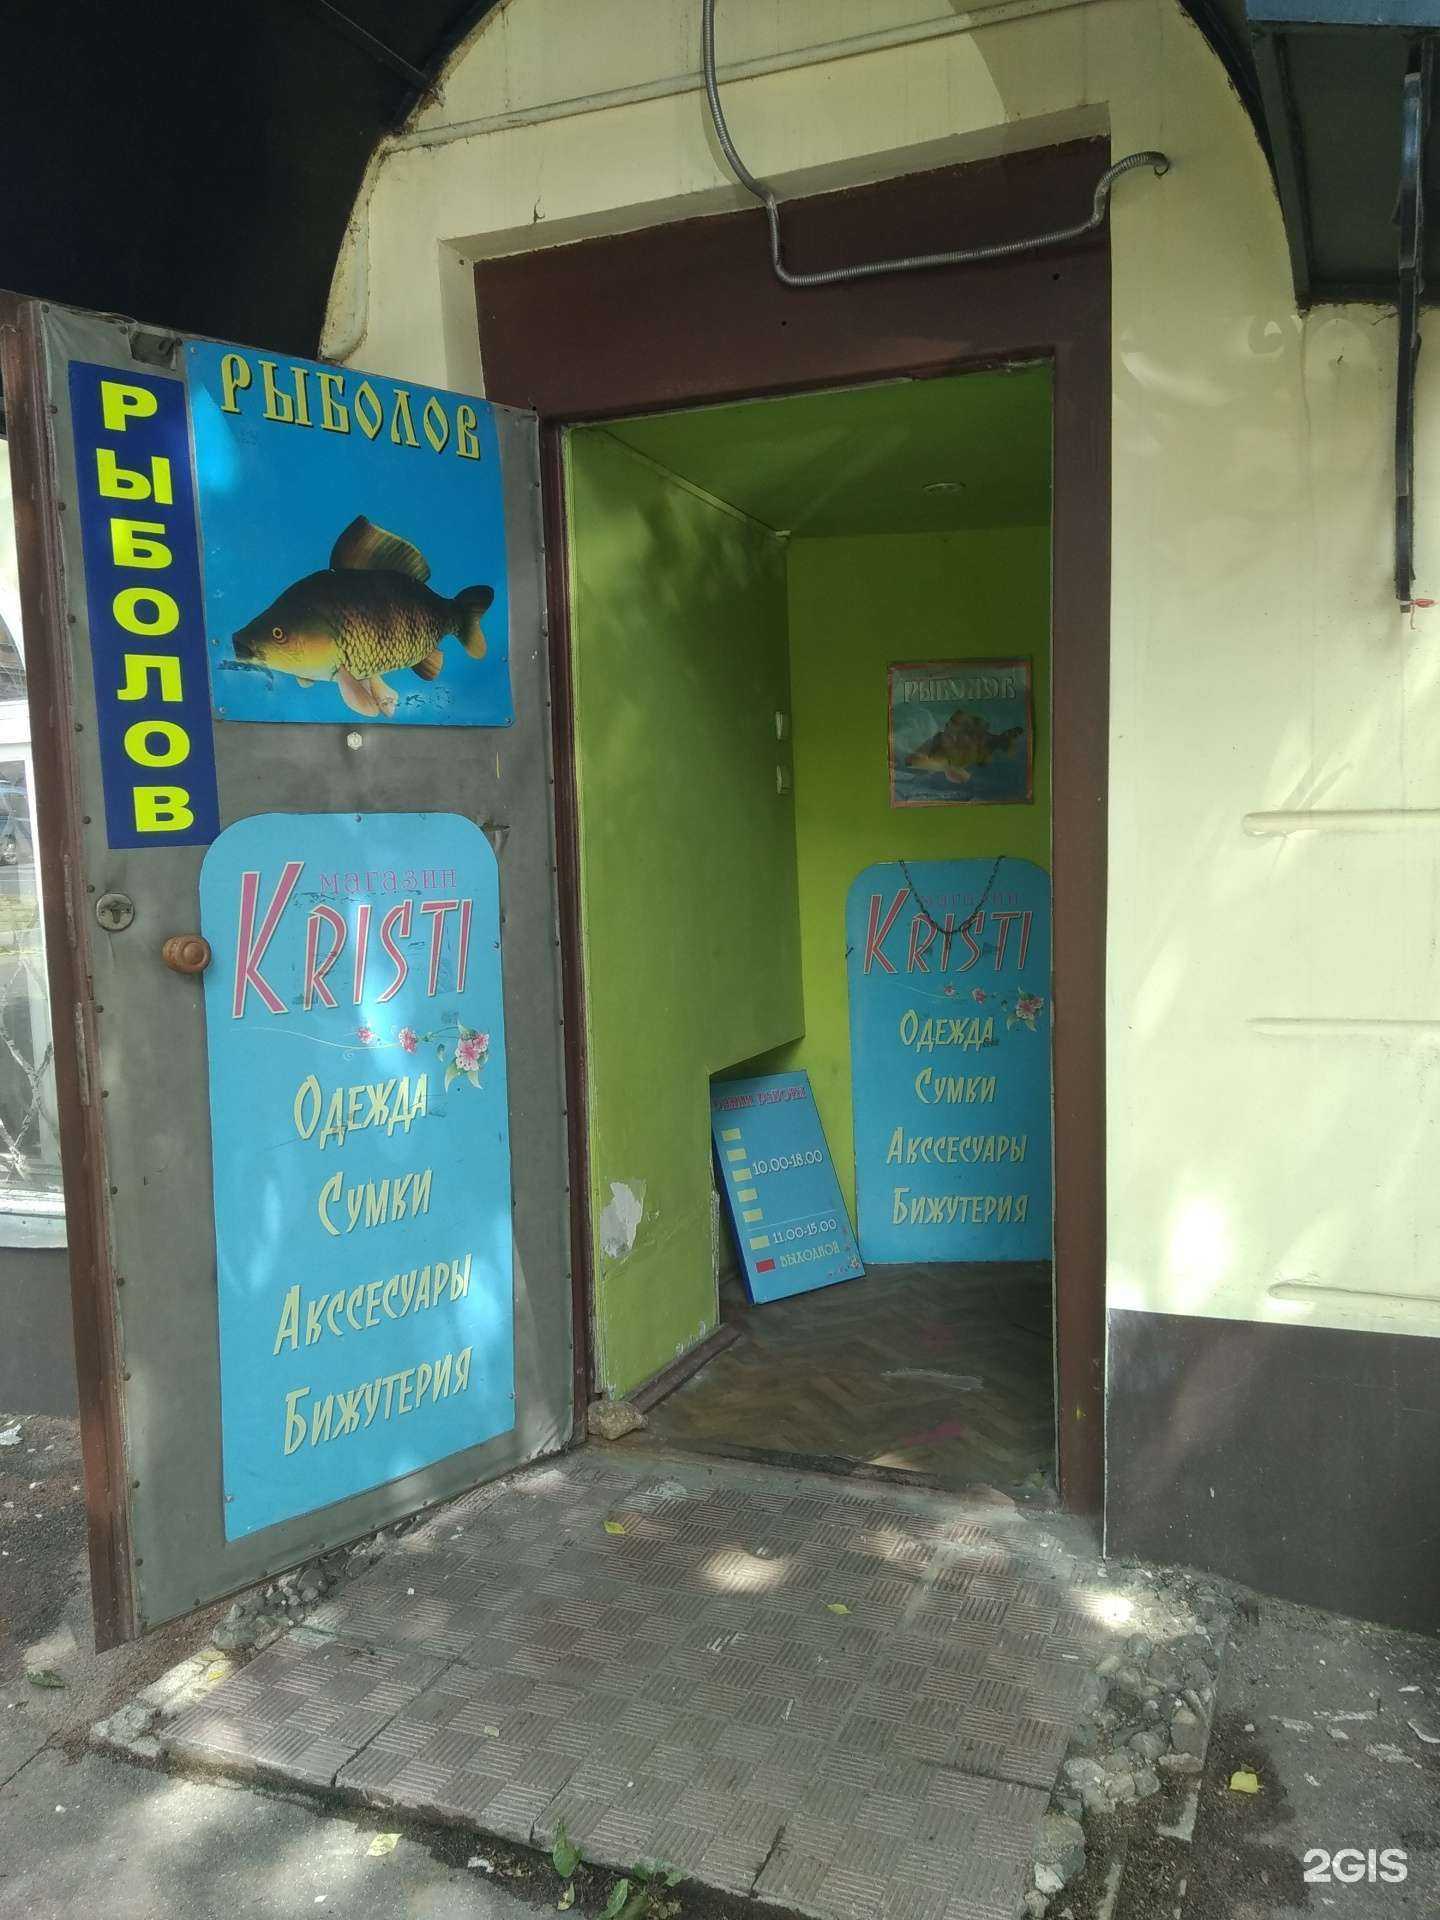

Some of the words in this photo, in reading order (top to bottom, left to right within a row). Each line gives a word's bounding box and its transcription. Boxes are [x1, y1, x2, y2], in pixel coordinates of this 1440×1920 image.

[220, 353, 481, 460] РЫБОЛОВ
[96, 380, 194, 833] РЫБОЛОВ
[319, 867, 458, 895] магазин
[752, 1150, 823, 1175] 10.00-18.00
